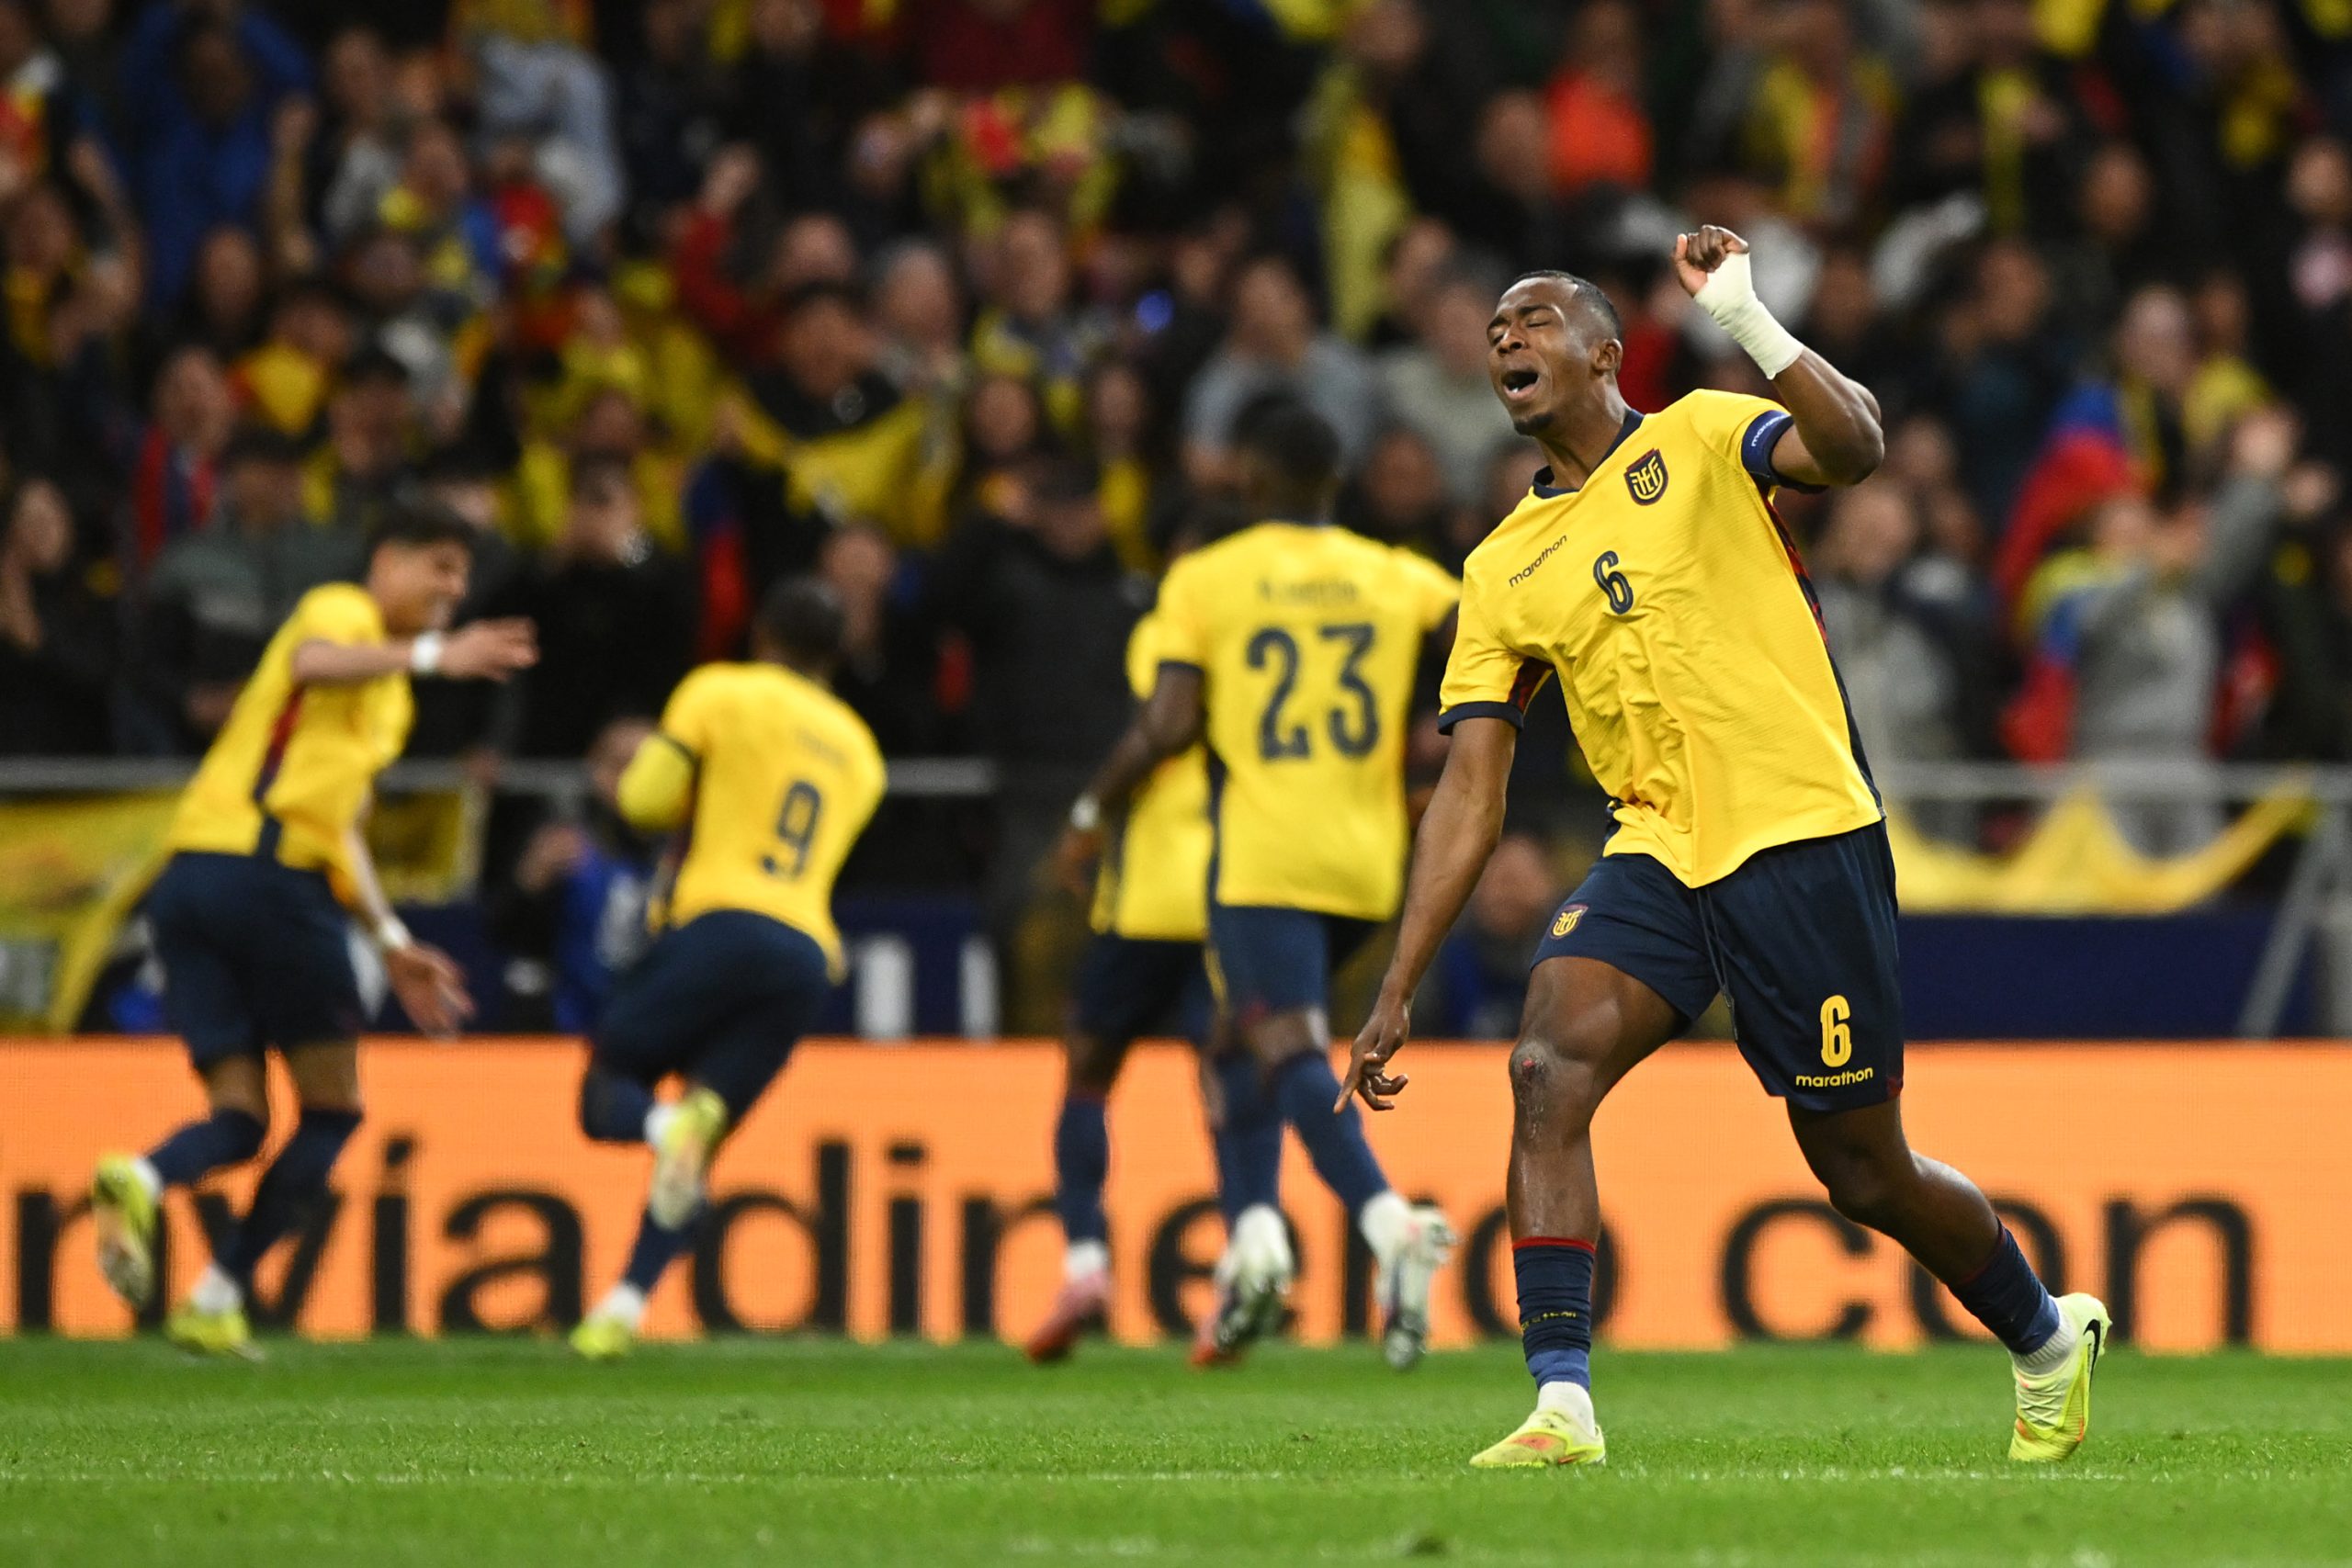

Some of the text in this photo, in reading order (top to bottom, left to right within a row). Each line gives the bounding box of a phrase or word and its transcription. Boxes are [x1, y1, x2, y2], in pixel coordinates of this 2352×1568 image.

[1751, 415, 1789, 447] mara
[1508, 535, 1567, 588] marathon
[1592, 550, 1634, 615] 6
[1247, 623, 1380, 761] 23
[762, 779, 823, 880] 9
[1820, 994, 1852, 1068] 6
[1795, 1066, 1874, 1088] marathon
